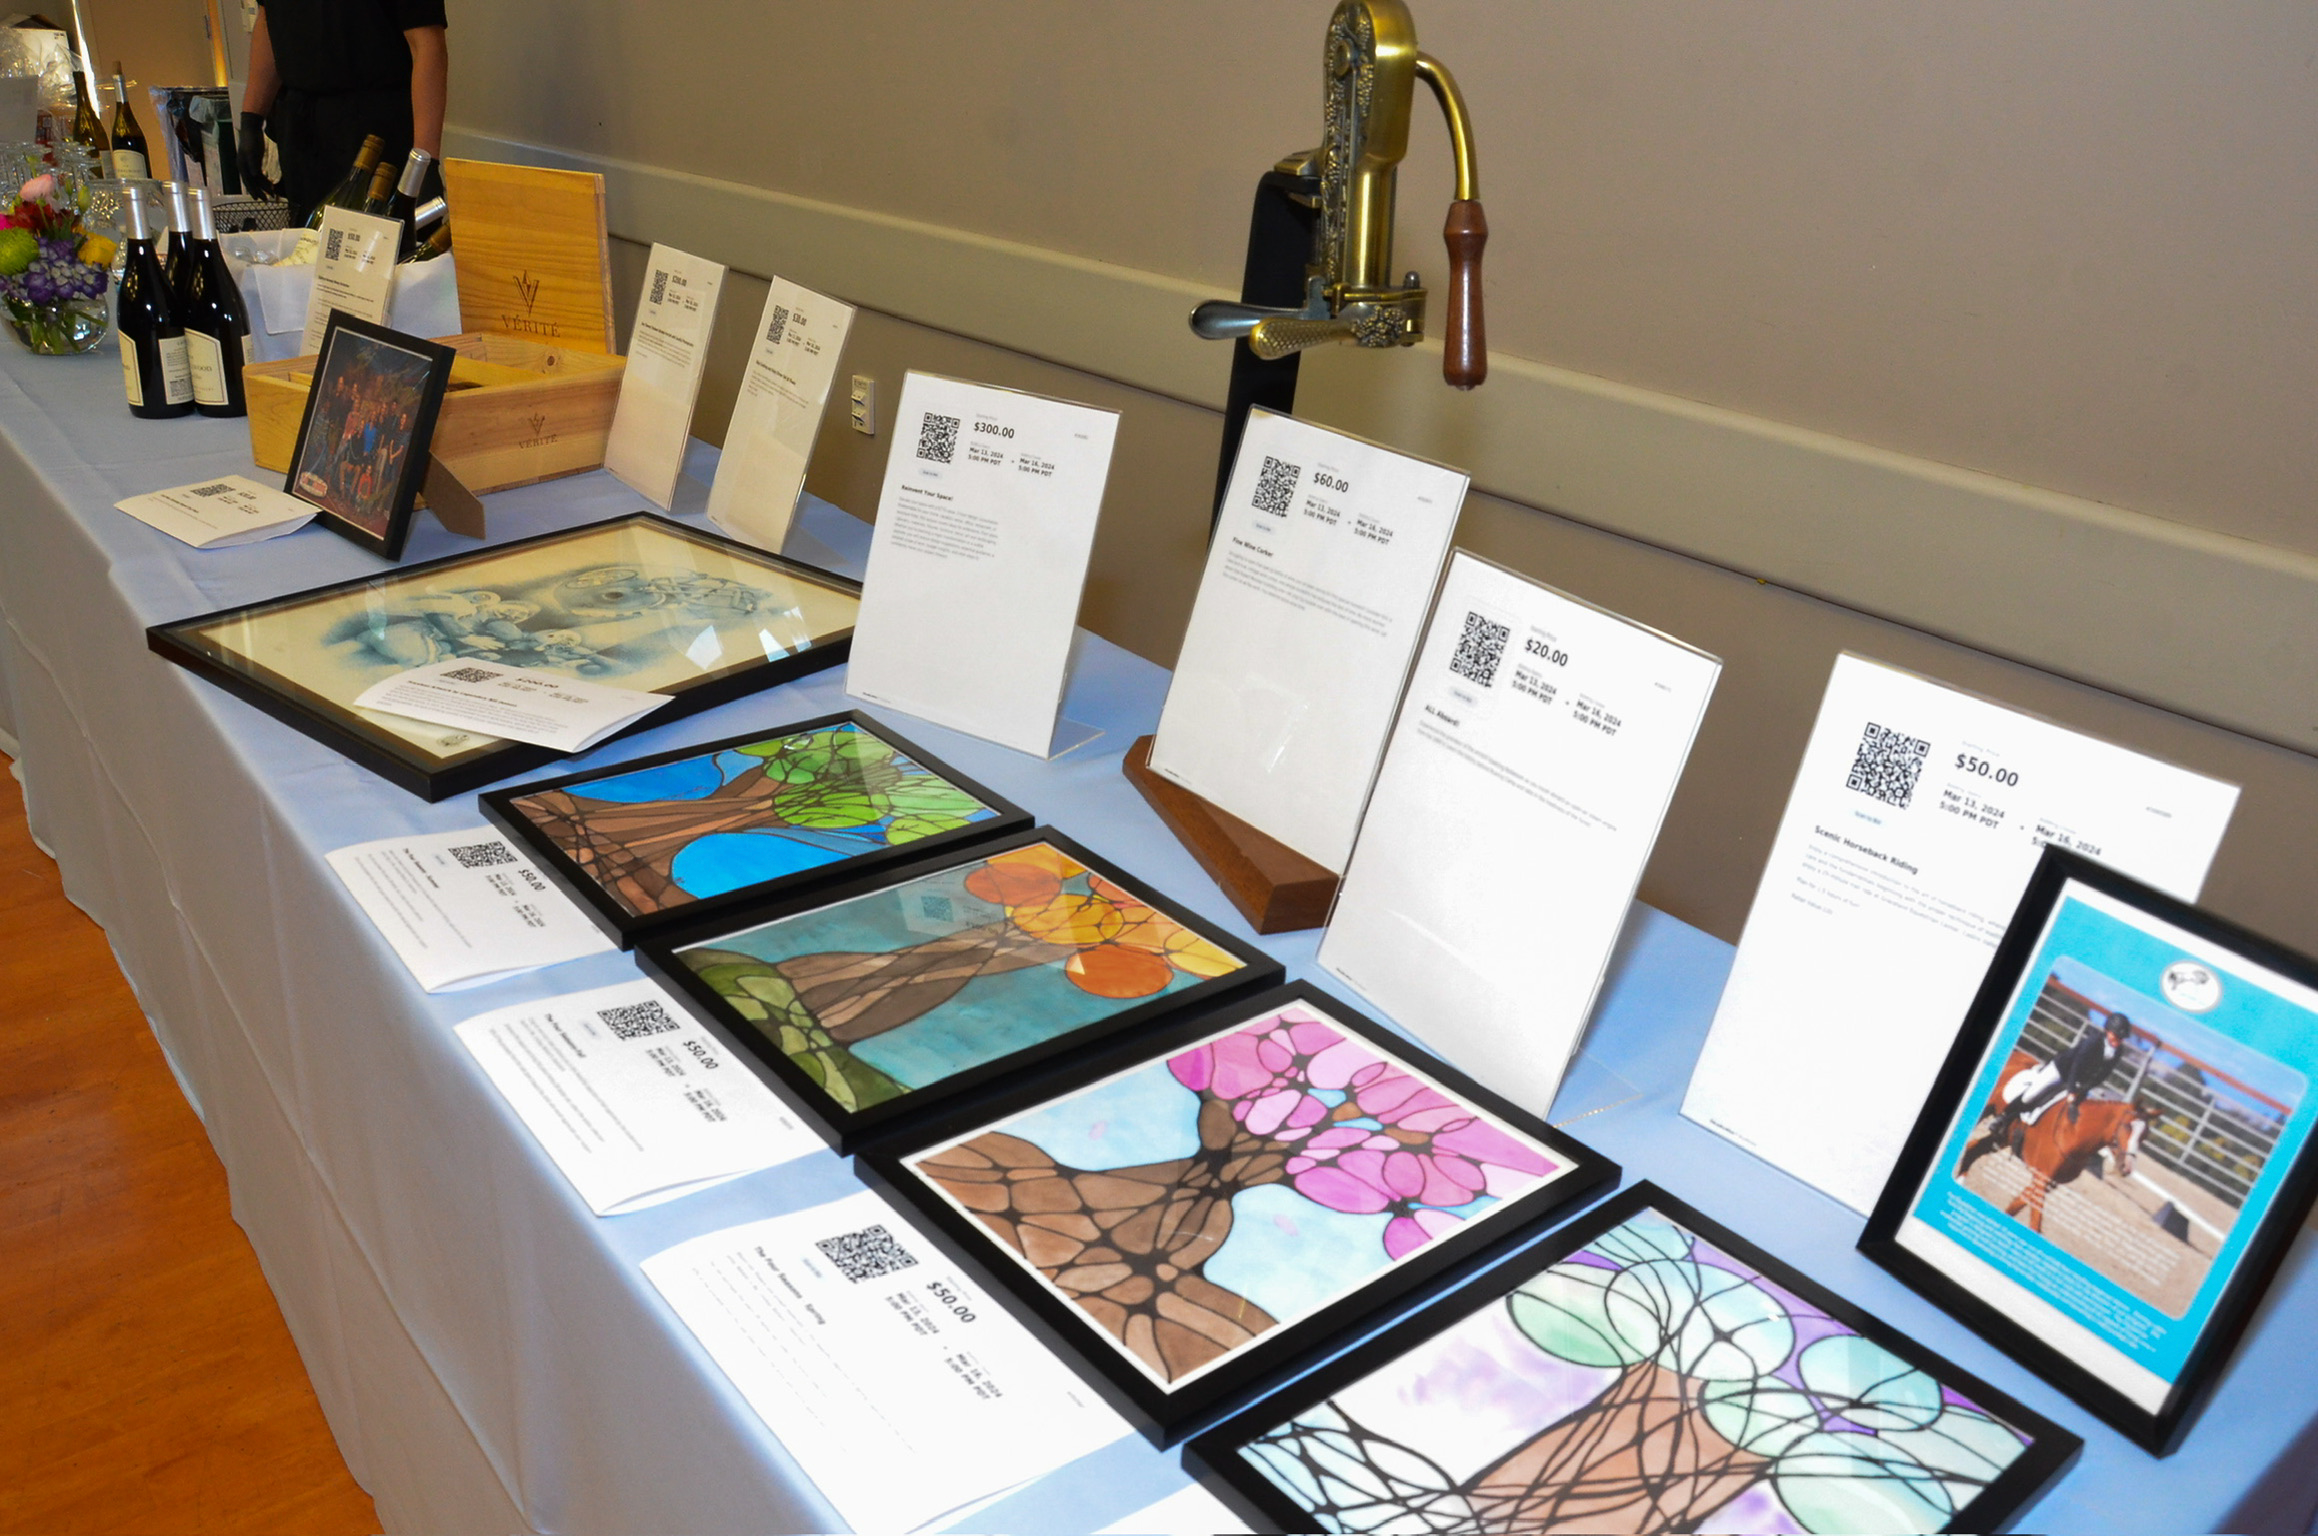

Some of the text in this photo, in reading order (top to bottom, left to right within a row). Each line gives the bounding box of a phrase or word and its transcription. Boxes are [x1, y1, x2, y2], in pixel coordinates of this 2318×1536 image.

[501, 314, 560, 338] VÉRITÉ
[974, 422, 1014, 439] $300.00
[518, 433, 558, 449] VÉRITÉ
[901, 485, 923, 494] Reinvent
[1314, 472, 1349, 493] $60.00
[1326, 517, 1337, 525] PDT
[1357, 519, 1367, 527] Mar
[1233, 537, 1243, 545] Fine
[1244, 542, 1256, 550] Wine
[1377, 536, 1389, 544] PDT
[1525, 639, 1568, 666] $20.00
[1516, 670, 1528, 681] Mar
[1527, 688, 1538, 696] PM
[1539, 693, 1552, 704] PDT
[1577, 701, 1590, 711] Mar
[1590, 719, 1601, 728] PM
[1602, 725, 1616, 735] PDT
[1955, 754, 2018, 786] $50.00
[1943, 790, 1961, 801] Mar
[1981, 804, 2004, 818] 2024
[1939, 801, 1999, 829] 5:00 PM PDT
[2032, 836, 2048, 849] 5:0
[2036, 825, 2054, 837] Mar
[2076, 841, 2101, 855] 2024
[1815, 825, 1918, 875] Scenic Horseback Riding
[518, 869, 546, 890] $50.00
[683, 1041, 718, 1069] $50.00
[755, 1246, 766, 1257] The
[765, 1258, 779, 1271] Four
[897, 1293, 910, 1304] Mar
[927, 1282, 976, 1323] $50.00
[901, 1311, 913, 1322] PM
[911, 1322, 928, 1335] PDT
[957, 1354, 970, 1366] Mar
[961, 1374, 975, 1385] PM
[973, 1386, 990, 1399] PDT
